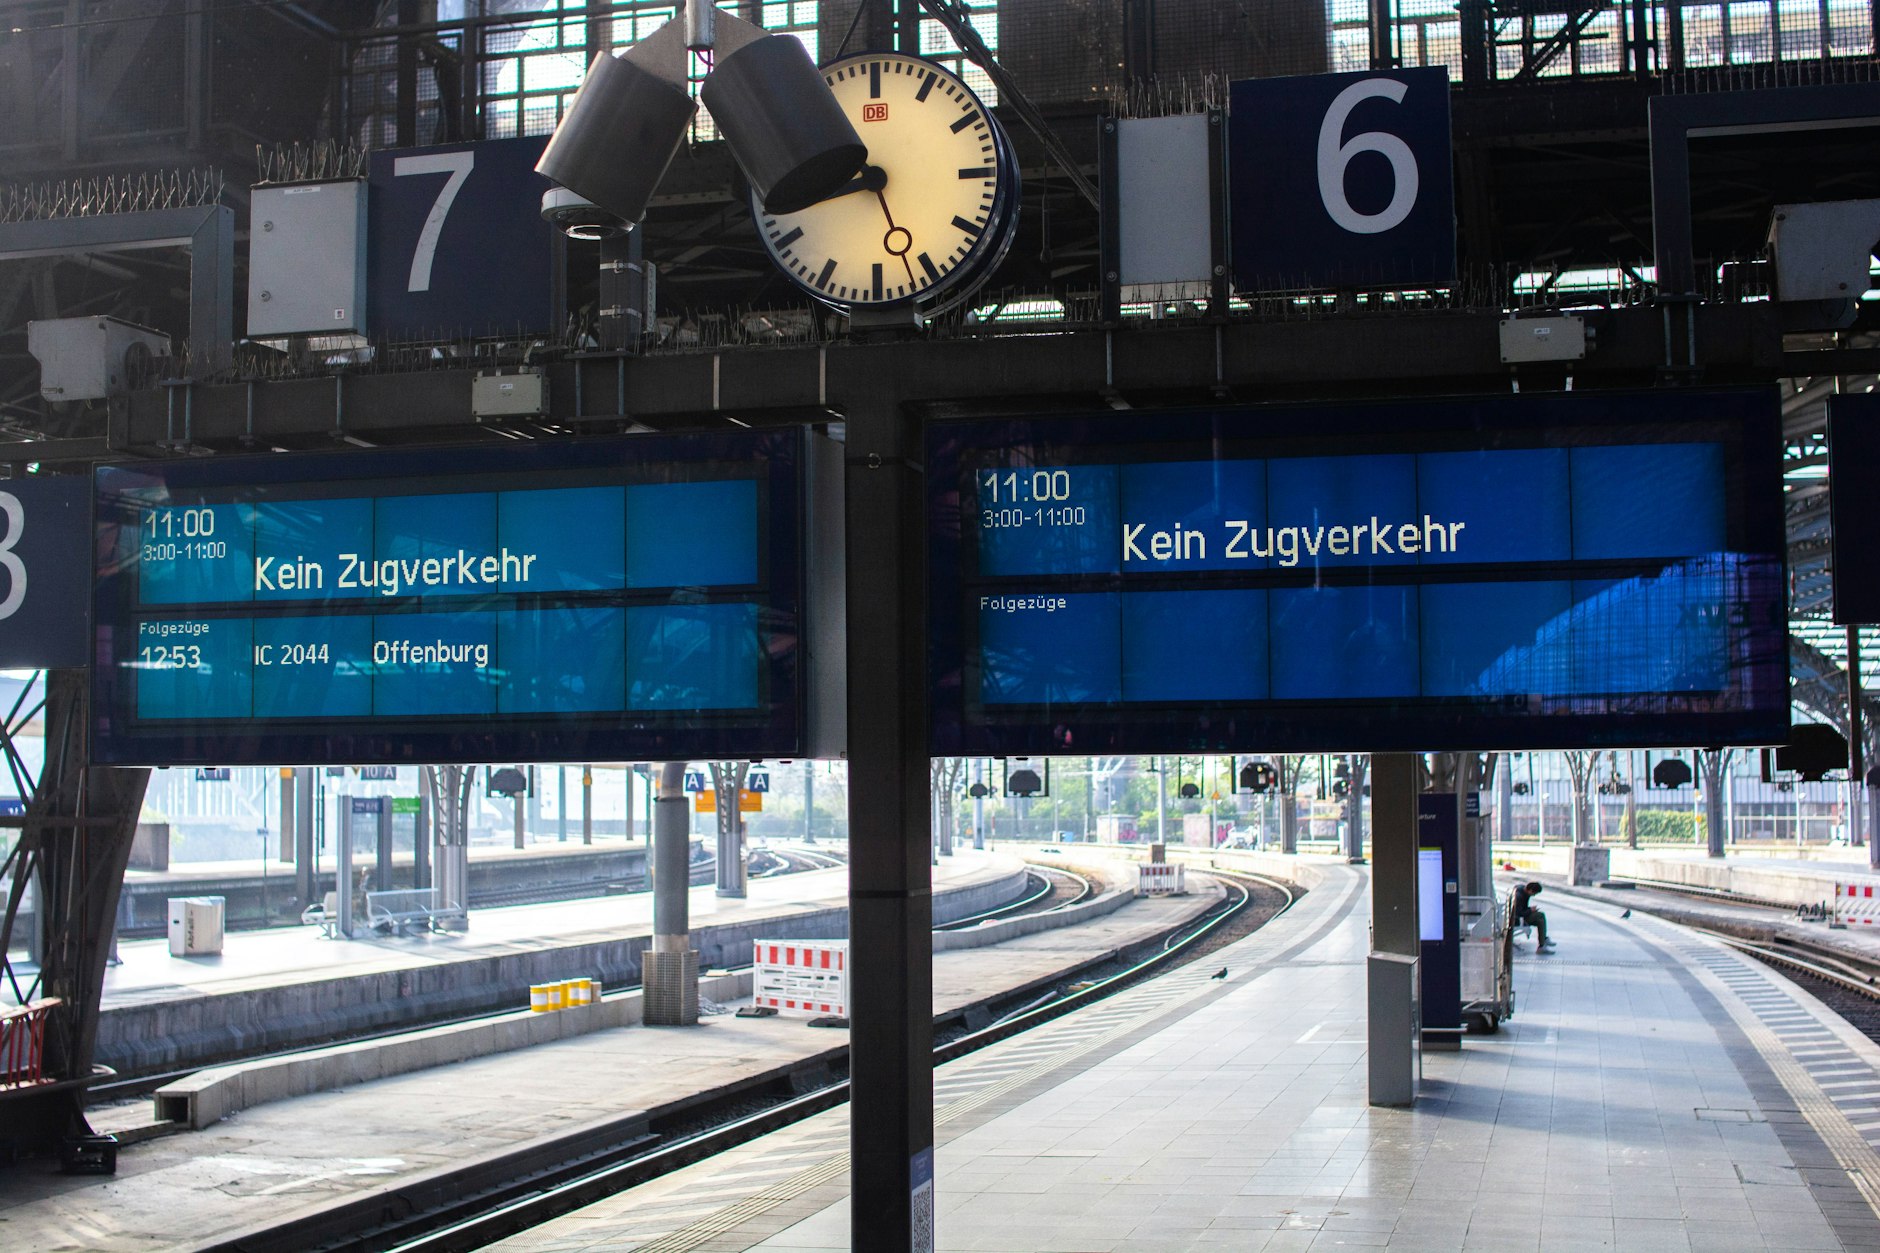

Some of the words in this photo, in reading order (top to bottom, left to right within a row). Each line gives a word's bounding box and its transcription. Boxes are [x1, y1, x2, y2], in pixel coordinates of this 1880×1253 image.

[866, 106, 885, 119] DB
[1317, 78, 1420, 234] 6
[393, 150, 475, 293] 7
[982, 469, 1070, 503] 11:00
[143, 506, 216, 538] 11:00
[982, 505, 1085, 528] 3:00-11:00
[142, 541, 227, 562] 3:00-11:00
[1122, 524, 1206, 562] Kein
[1224, 515, 1465, 567] Zugverkehr
[254, 555, 324, 592] Kein
[337, 548, 537, 596] Zugverkehr
[979, 595, 1068, 614] Folgezüge
[139, 620, 210, 638] Folgezüge
[139, 644, 202, 670] 12:53
[254, 645, 273, 666] IC
[279, 643, 330, 665] 2044
[372, 639, 489, 669] Offenburg
[687, 773, 699, 788] A
[754, 773, 766, 788] A
